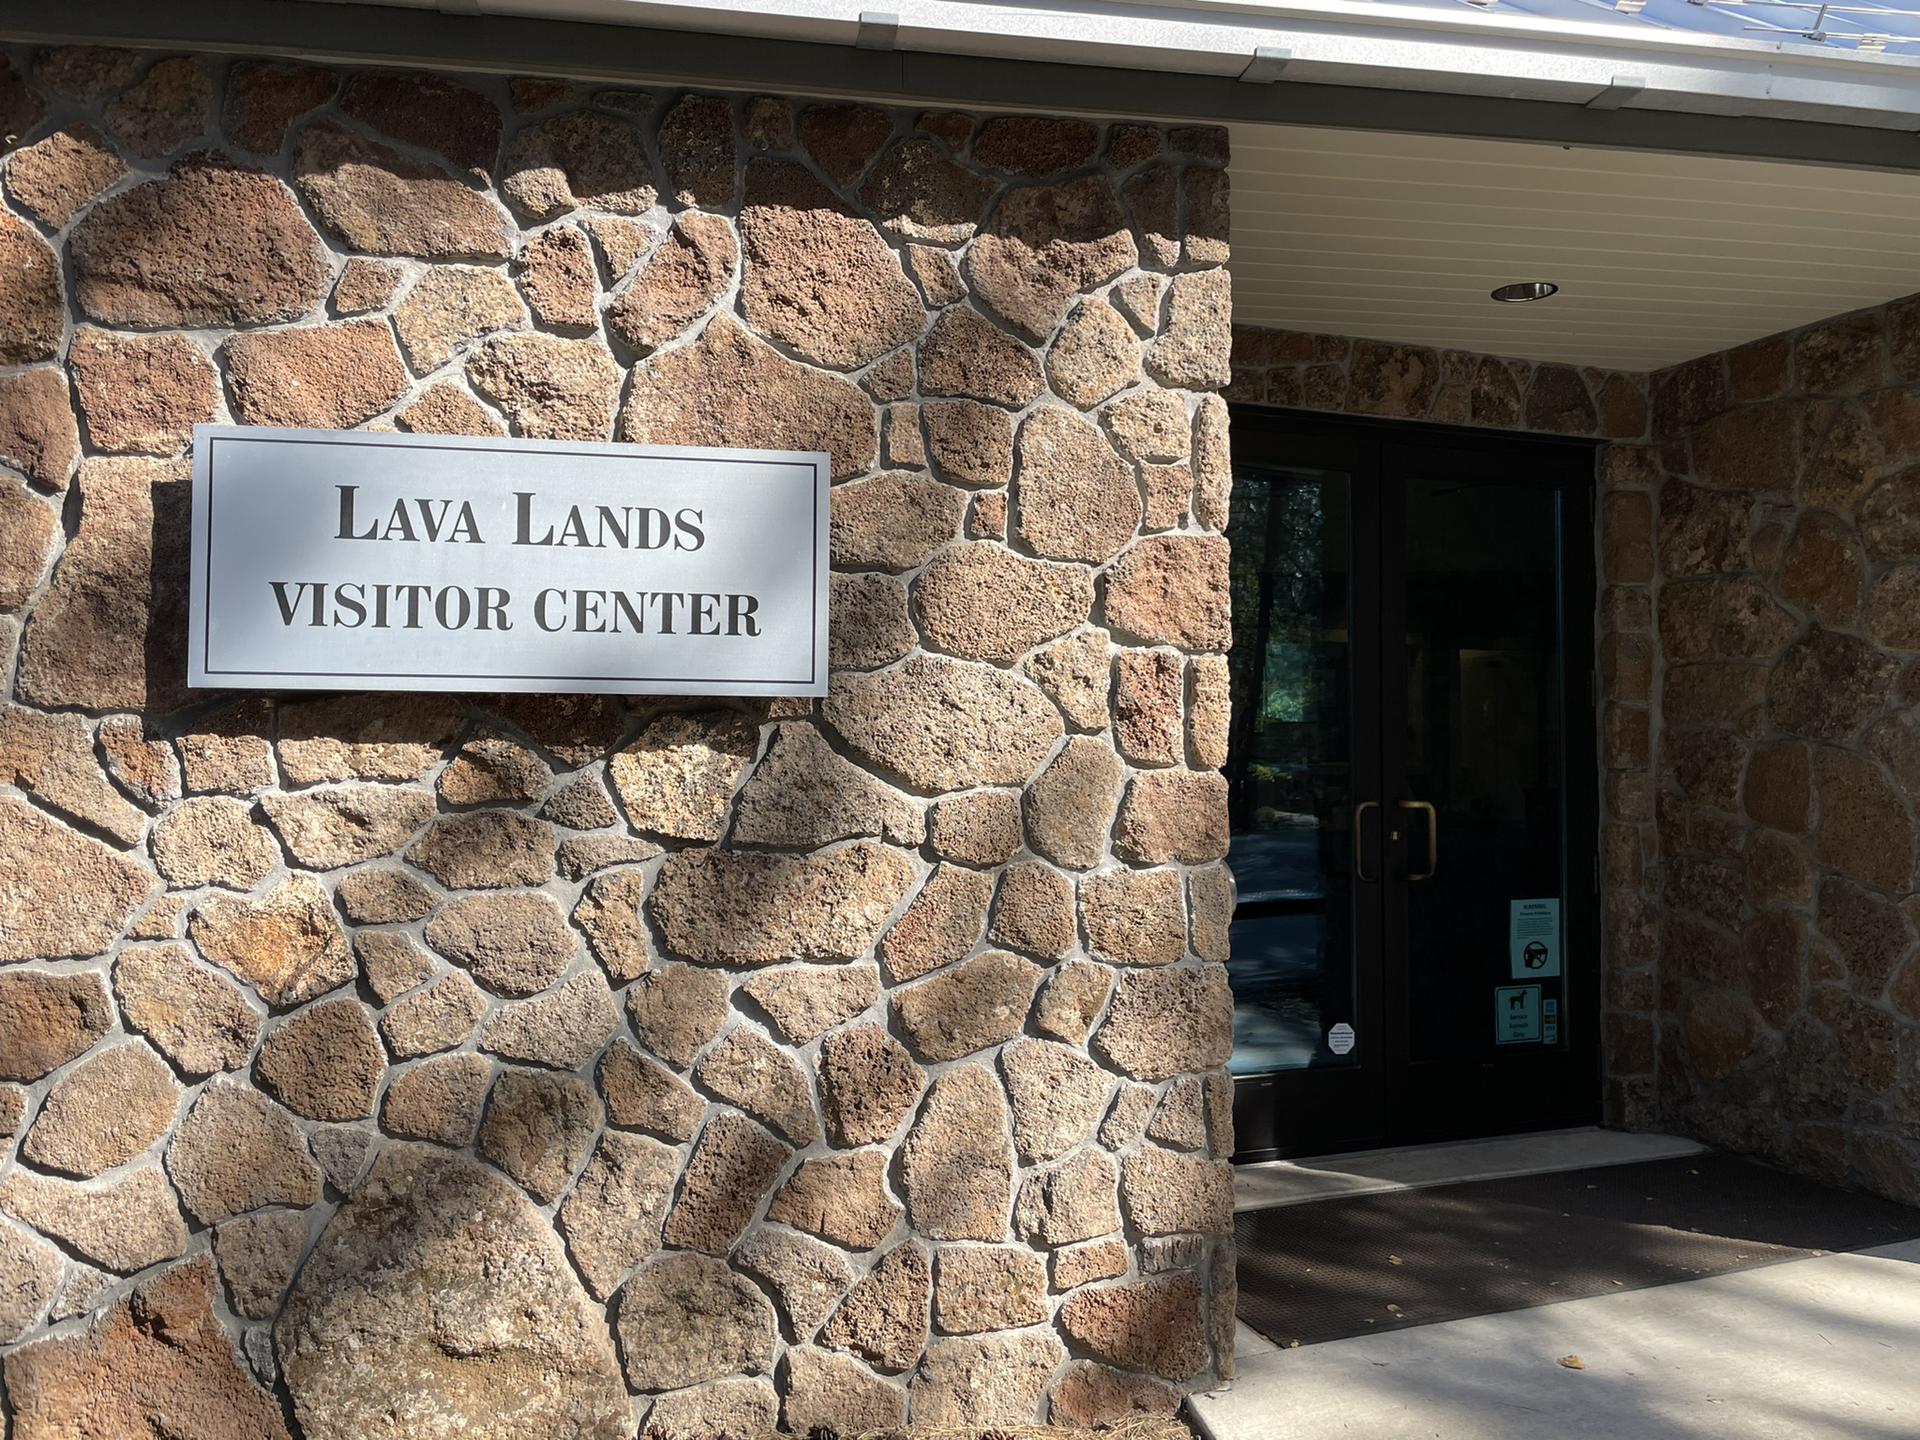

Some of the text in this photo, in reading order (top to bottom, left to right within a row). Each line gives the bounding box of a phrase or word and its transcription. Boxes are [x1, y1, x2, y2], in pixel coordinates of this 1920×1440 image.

[334, 484, 705, 552] LAVA LANDS
[268, 581, 762, 637] VISITOR CENTER
